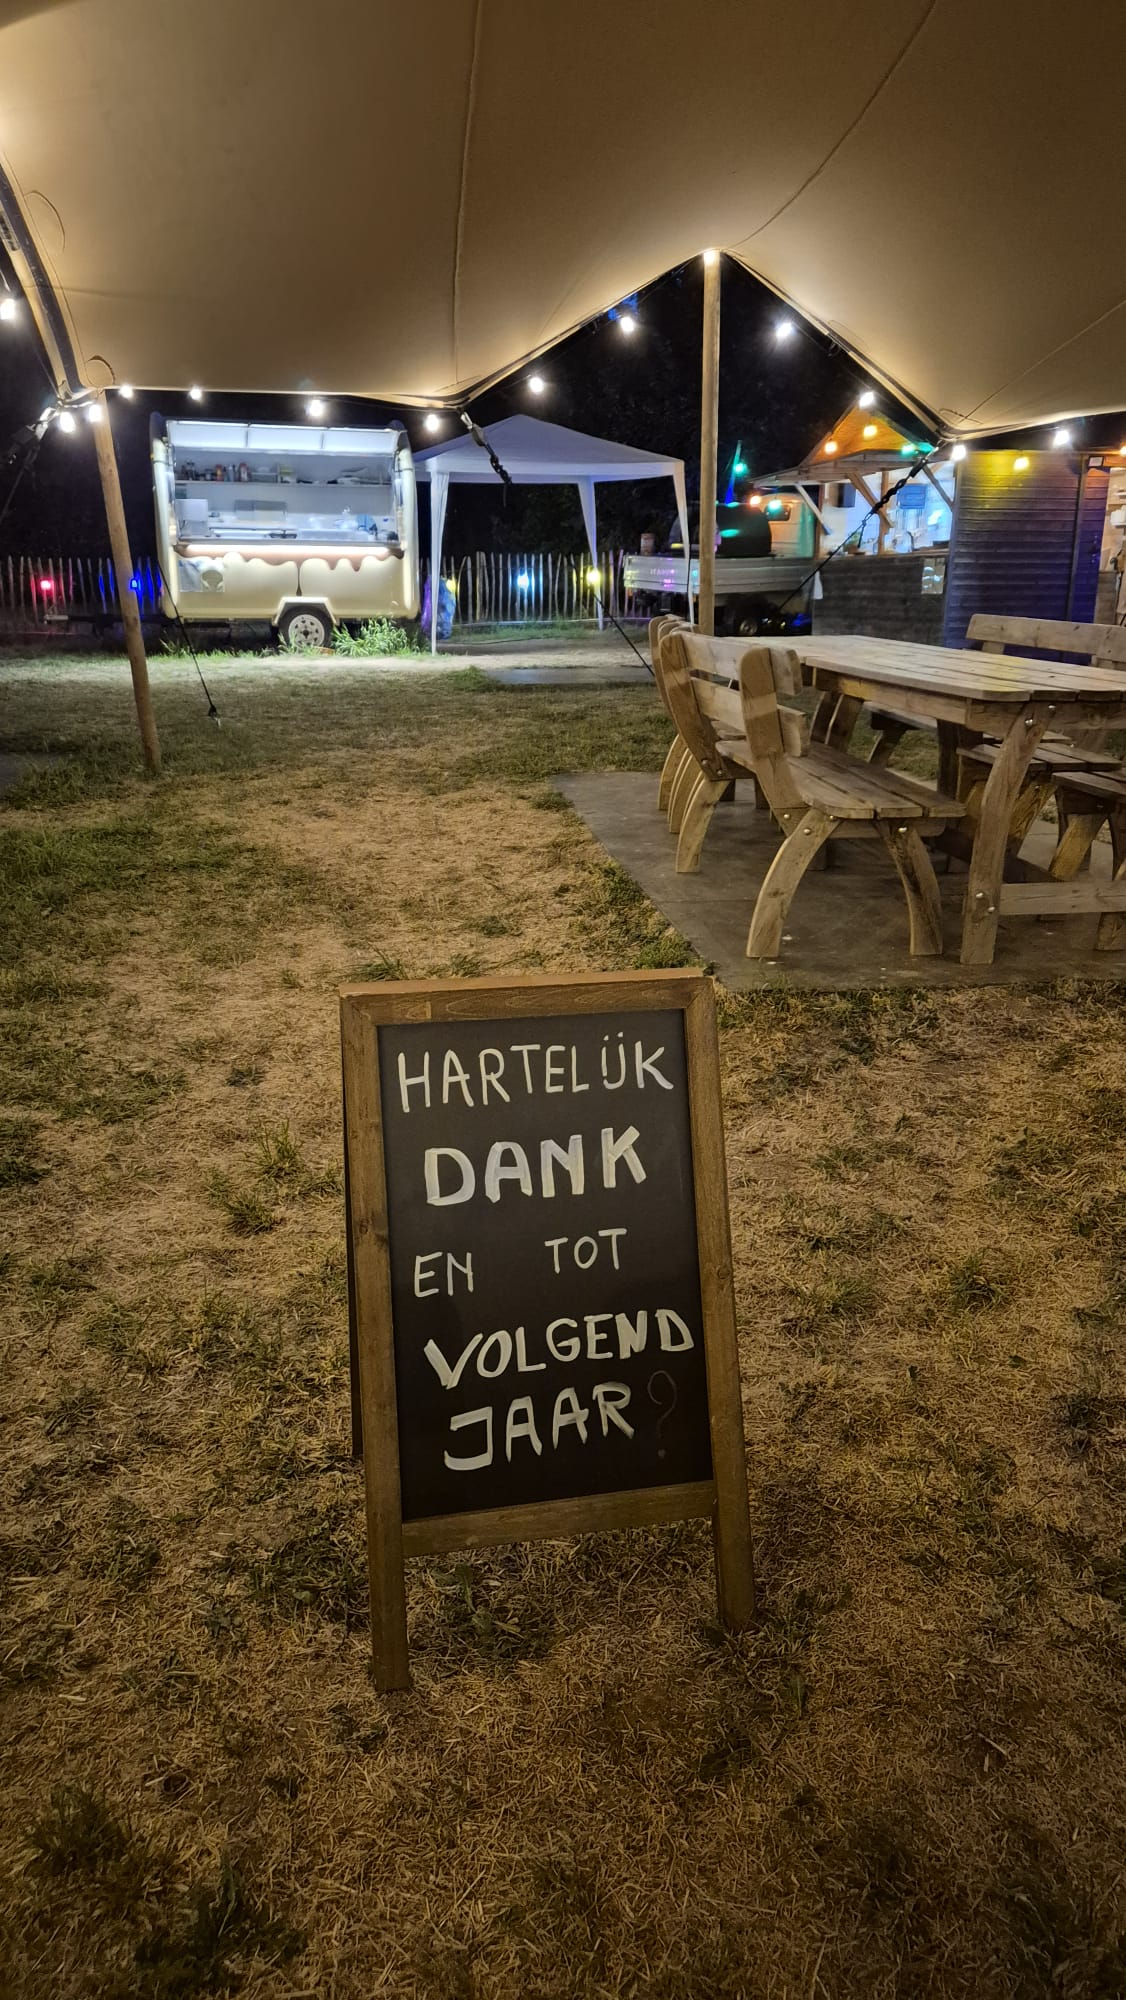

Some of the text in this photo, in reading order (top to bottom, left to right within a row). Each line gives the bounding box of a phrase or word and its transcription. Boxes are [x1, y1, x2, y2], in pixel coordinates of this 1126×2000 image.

[424, 1126, 647, 1206] DANK
[414, 1228, 628, 1298] EN TOT
[424, 1309, 695, 1389] VOLGEND
